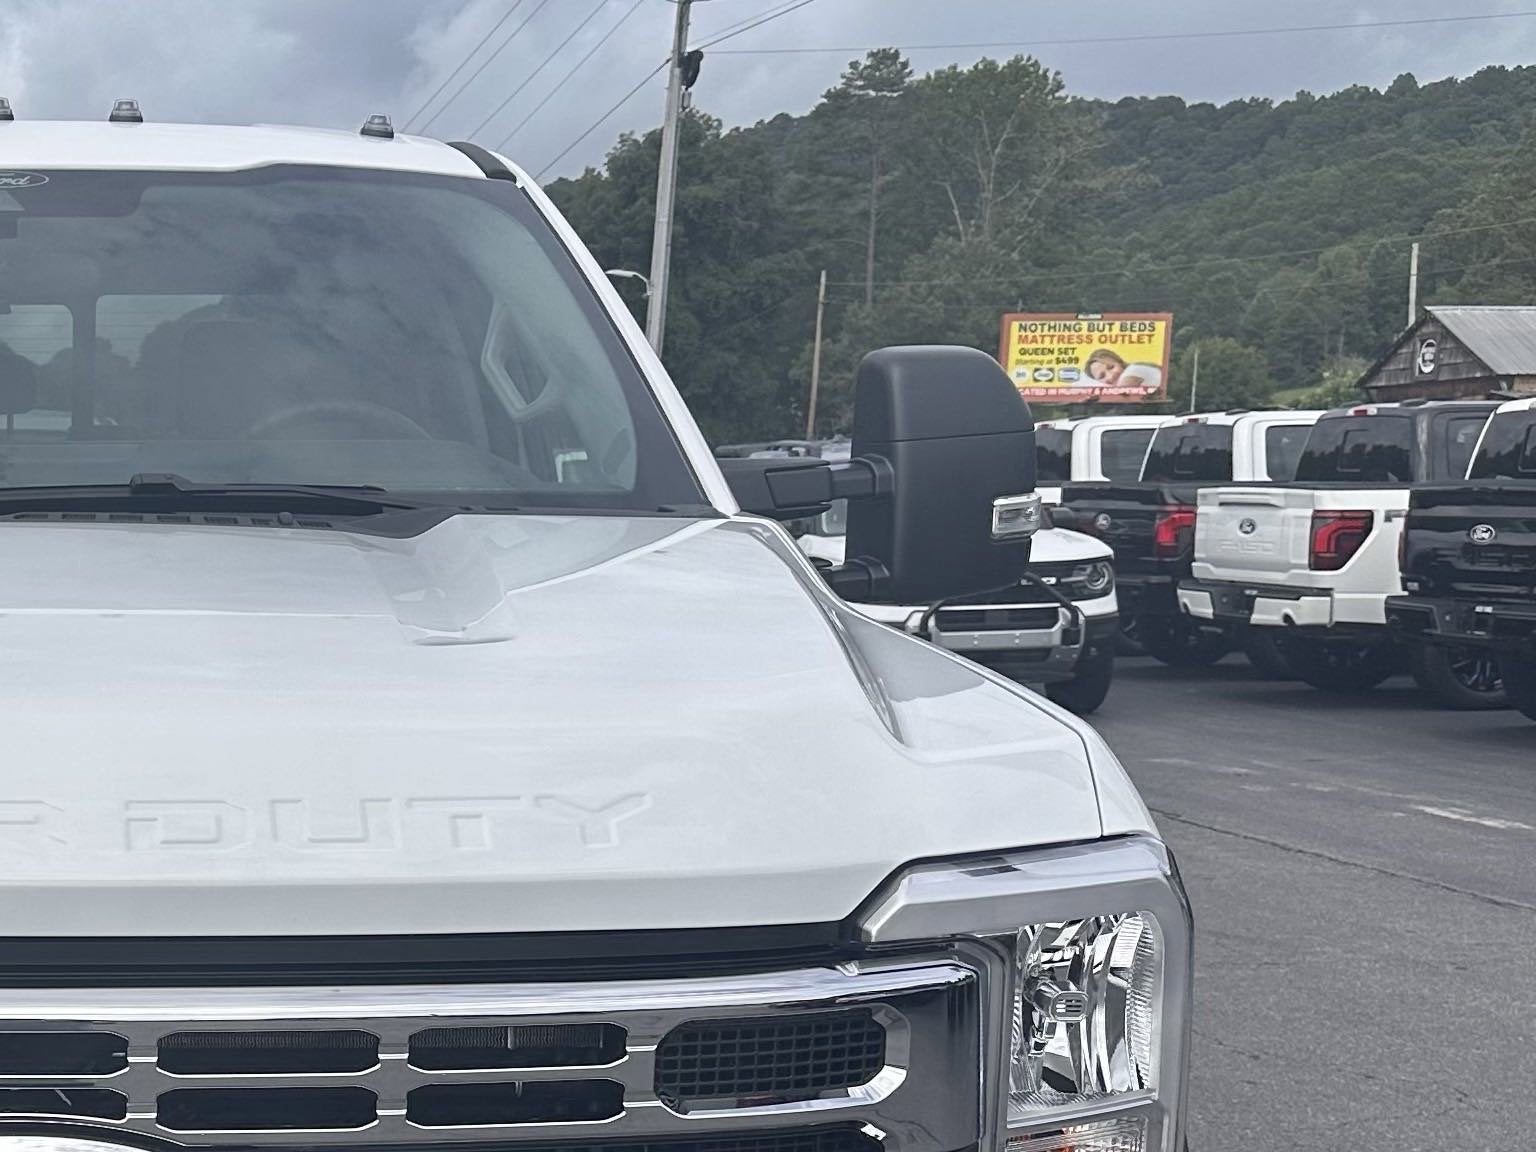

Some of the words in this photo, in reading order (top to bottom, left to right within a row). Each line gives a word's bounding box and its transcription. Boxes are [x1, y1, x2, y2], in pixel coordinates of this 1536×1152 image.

[1018, 322, 1083, 333] NOTHING
[1087, 322, 1115, 333] BUT
[1119, 321, 1156, 333] BEDS
[1017, 334, 1094, 345] MATTRESS
[1098, 333, 1155, 345] OUTLET
[1018, 347, 1055, 356] QUEEN
[1057, 347, 1077, 356] SET
[1055, 356, 1080, 366] $499
[124, 791, 652, 851] DUTY
